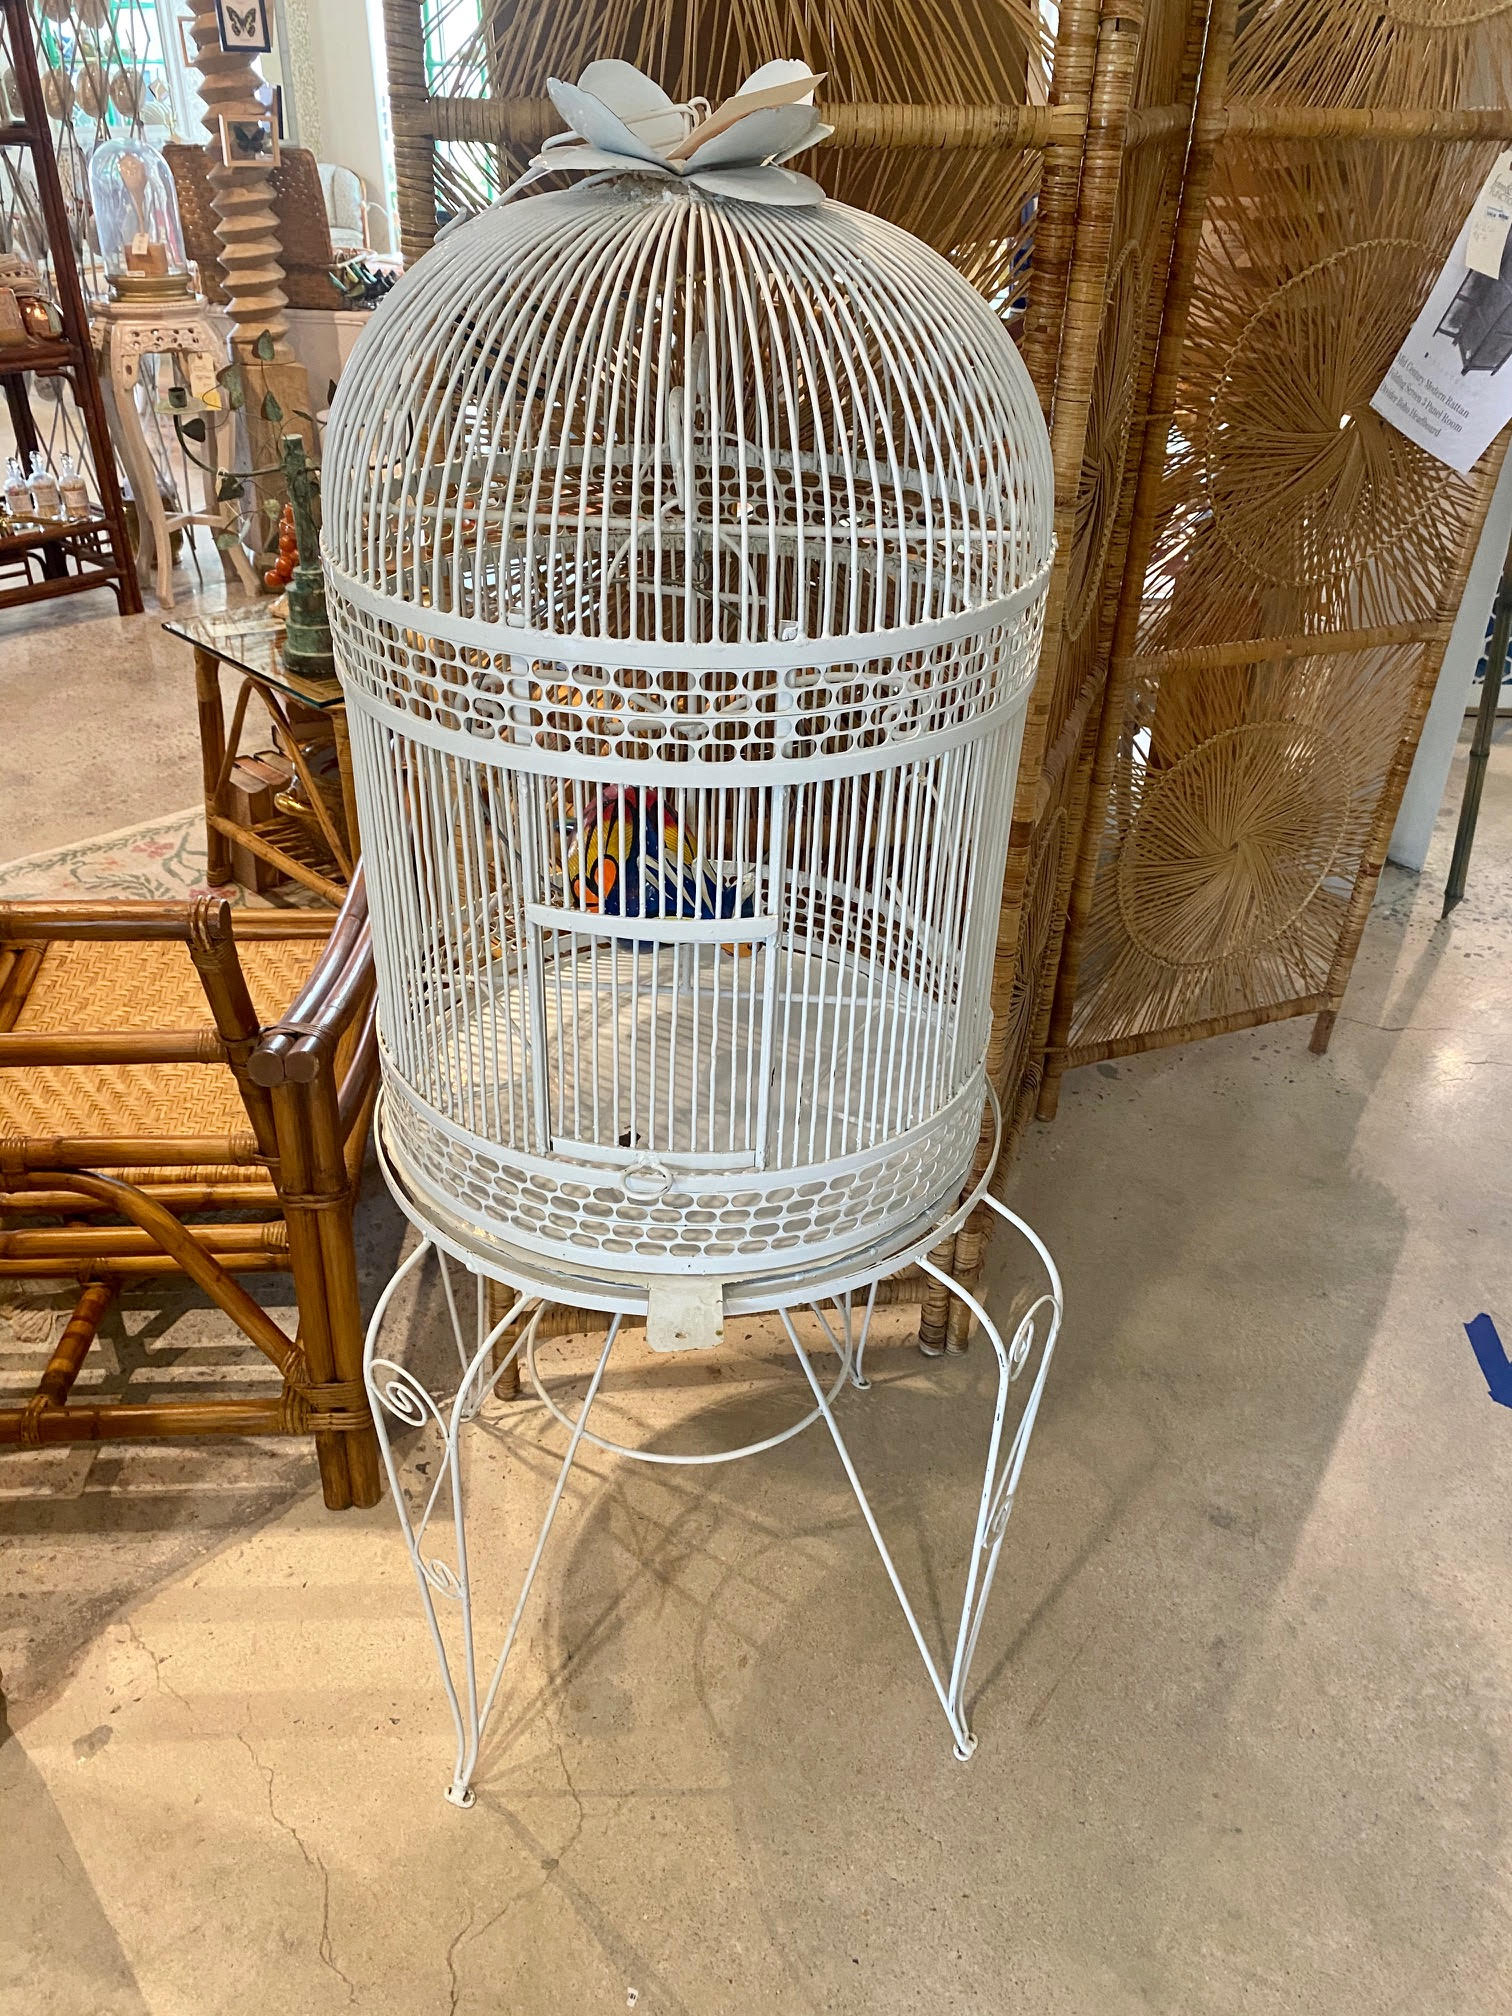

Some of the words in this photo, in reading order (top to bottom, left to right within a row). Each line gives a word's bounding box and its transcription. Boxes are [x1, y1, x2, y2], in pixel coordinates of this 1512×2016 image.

[1406, 361, 1424, 385] Century
[1425, 379, 1446, 402] Modern
[1445, 396, 1469, 418] Rattan
[1407, 383, 1422, 403] Screen
[1425, 400, 1443, 419] Panel
[1441, 413, 1463, 433] Room
[1409, 408, 1441, 437] Headboard
